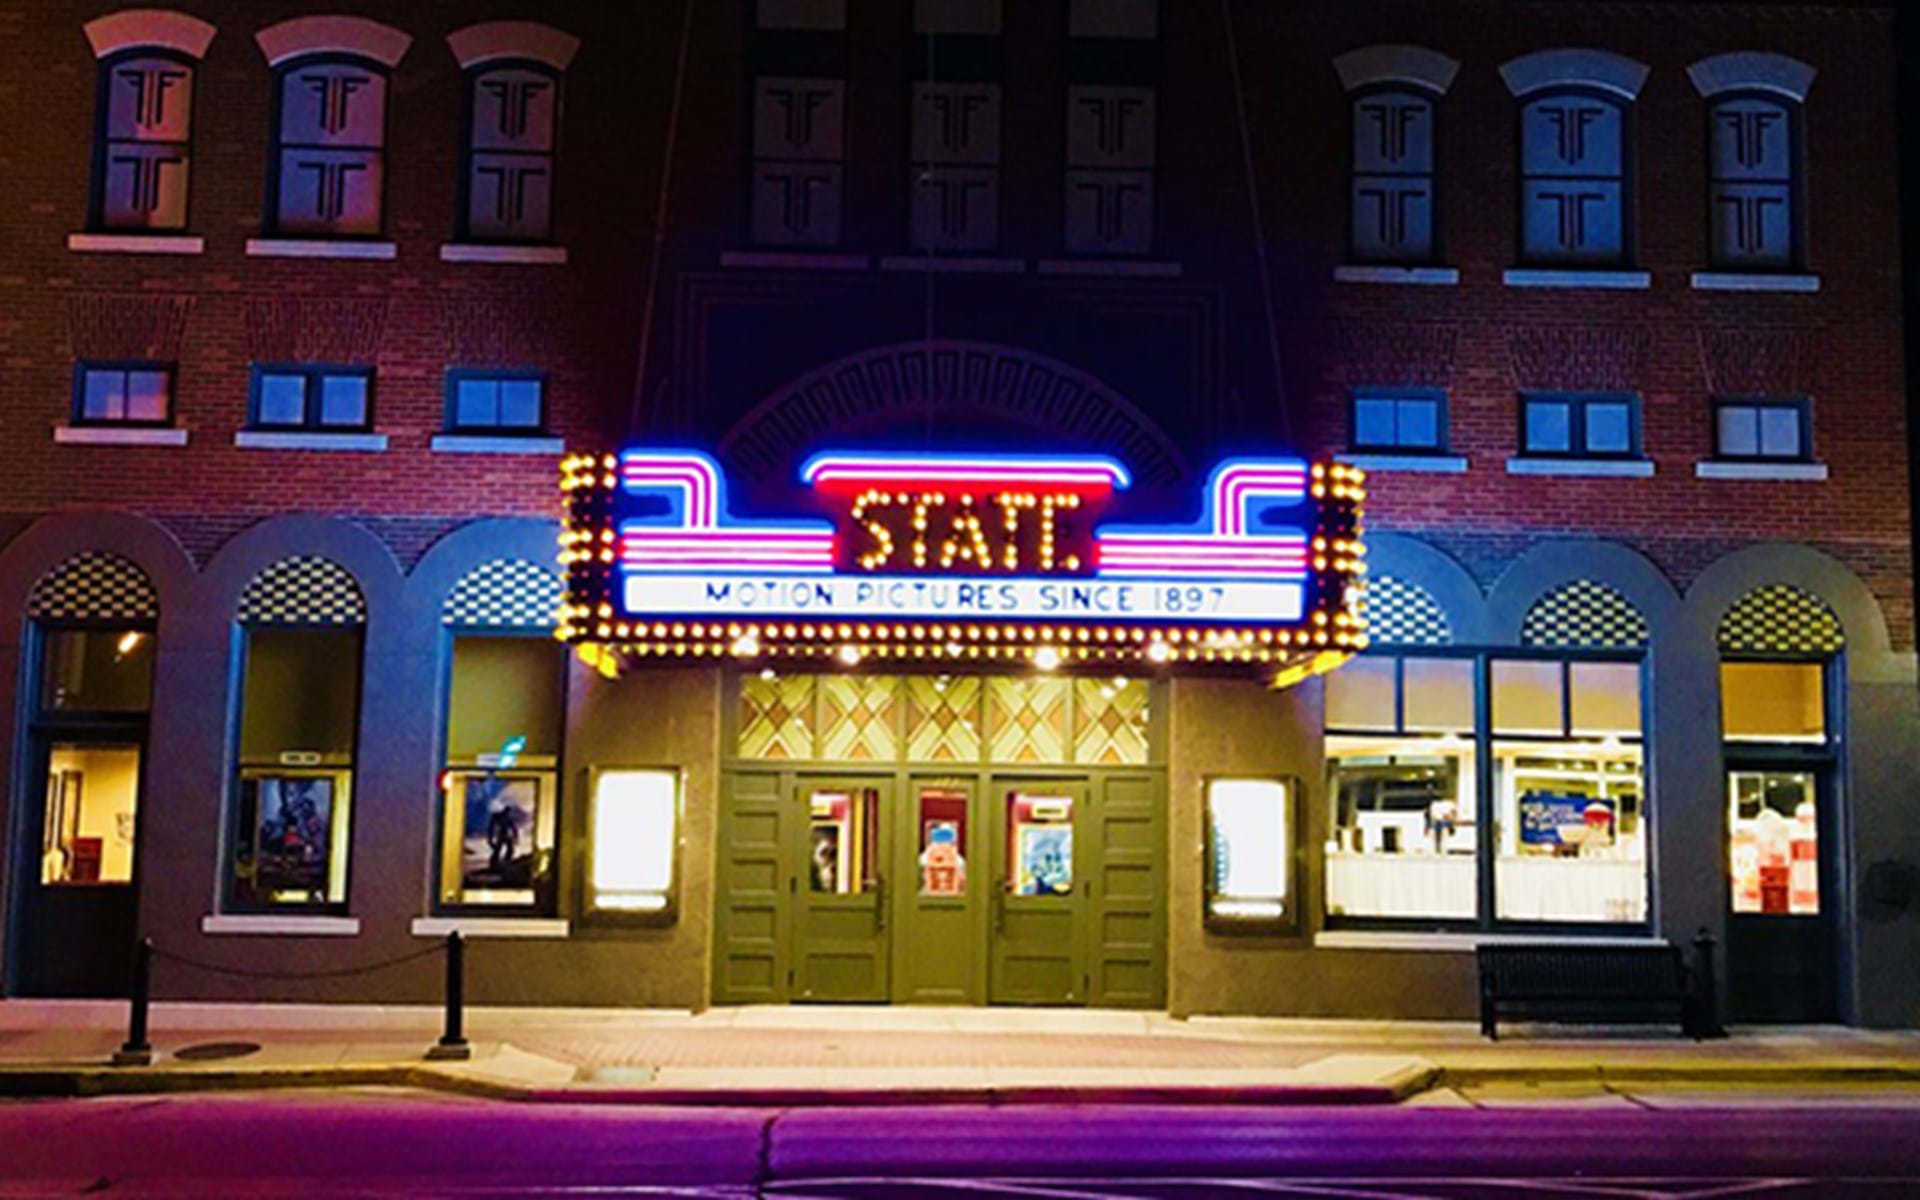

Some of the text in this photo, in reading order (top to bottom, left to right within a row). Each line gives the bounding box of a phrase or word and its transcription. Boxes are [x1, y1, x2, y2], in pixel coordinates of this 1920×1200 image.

[852, 488, 1080, 570] STATE
[706, 582, 1225, 612] MOTION PICTURES SINCE 1897
